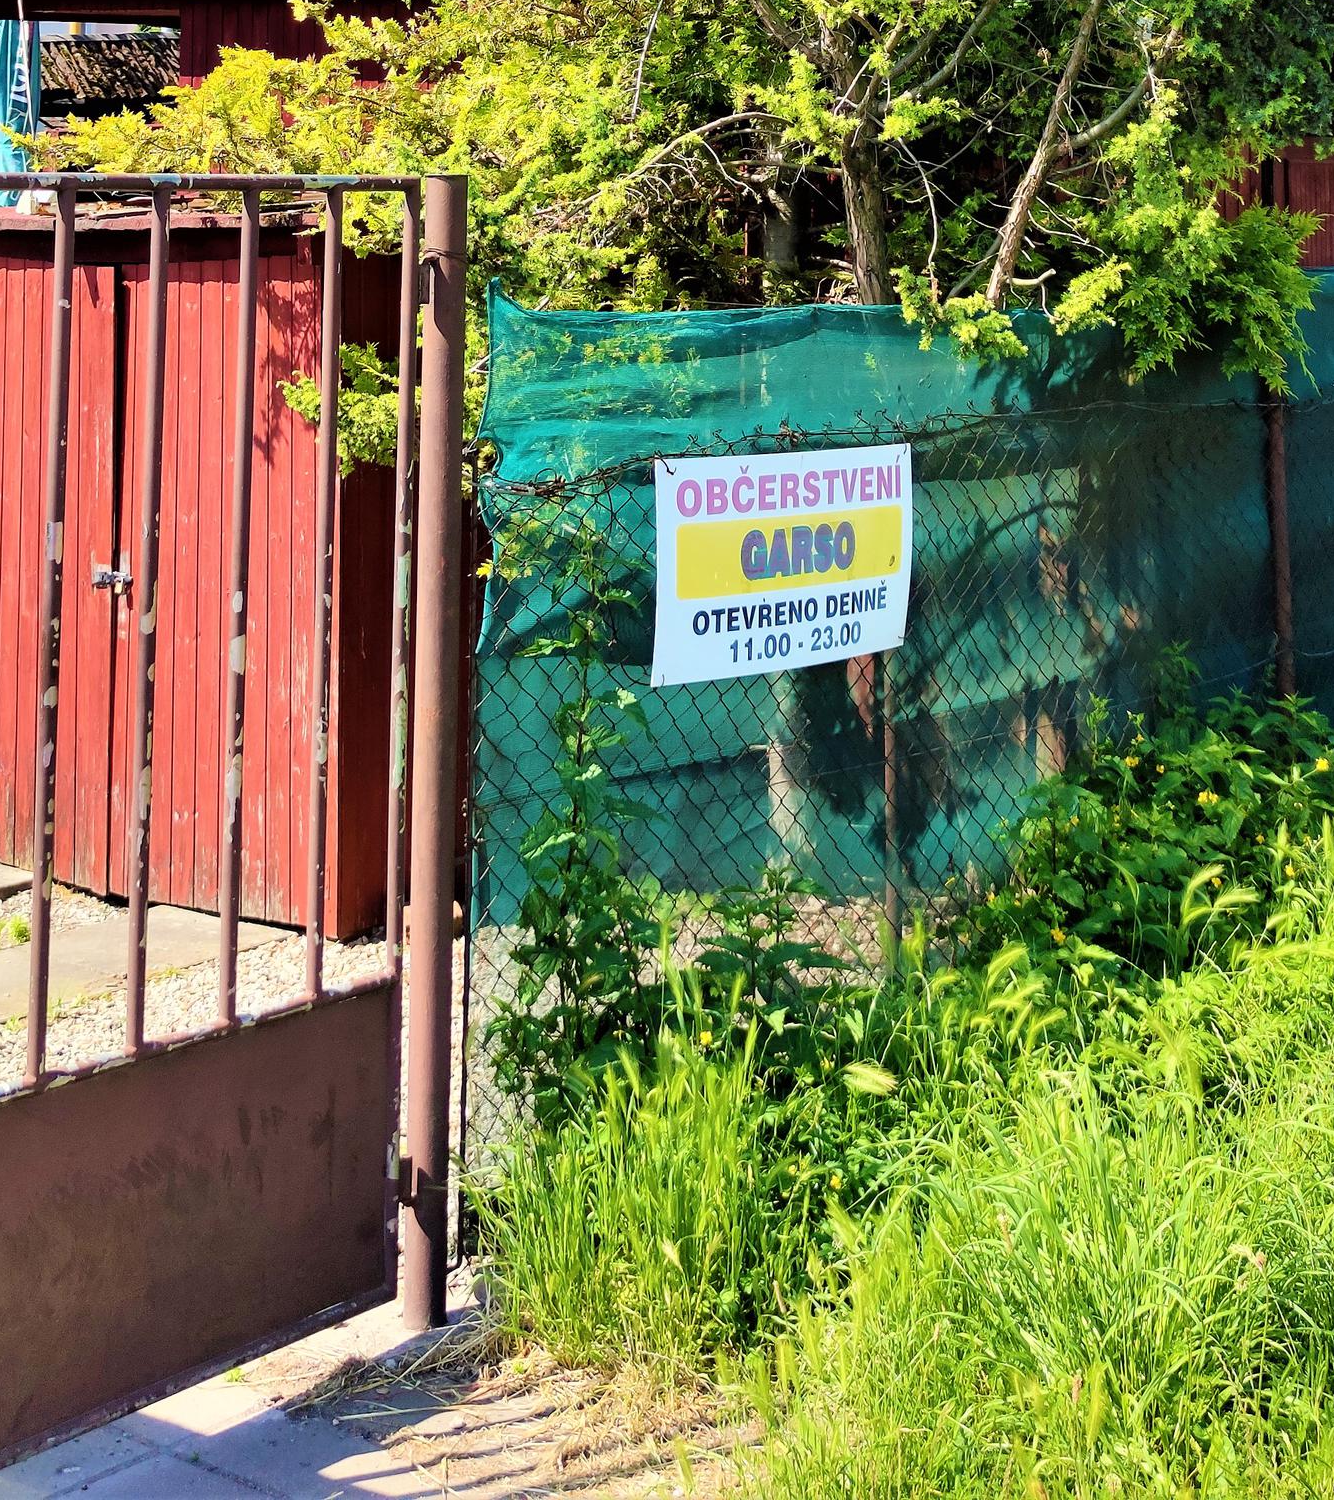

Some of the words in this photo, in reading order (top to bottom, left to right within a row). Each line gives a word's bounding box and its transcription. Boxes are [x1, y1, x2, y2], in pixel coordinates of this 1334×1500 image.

[676, 454, 901, 518] OBČERSTVENÍ
[740, 520, 856, 581] GARSO
[826, 579, 888, 619] DENNĚ
[730, 632, 791, 663] 11.00
[810, 620, 862, 652] 23.00
